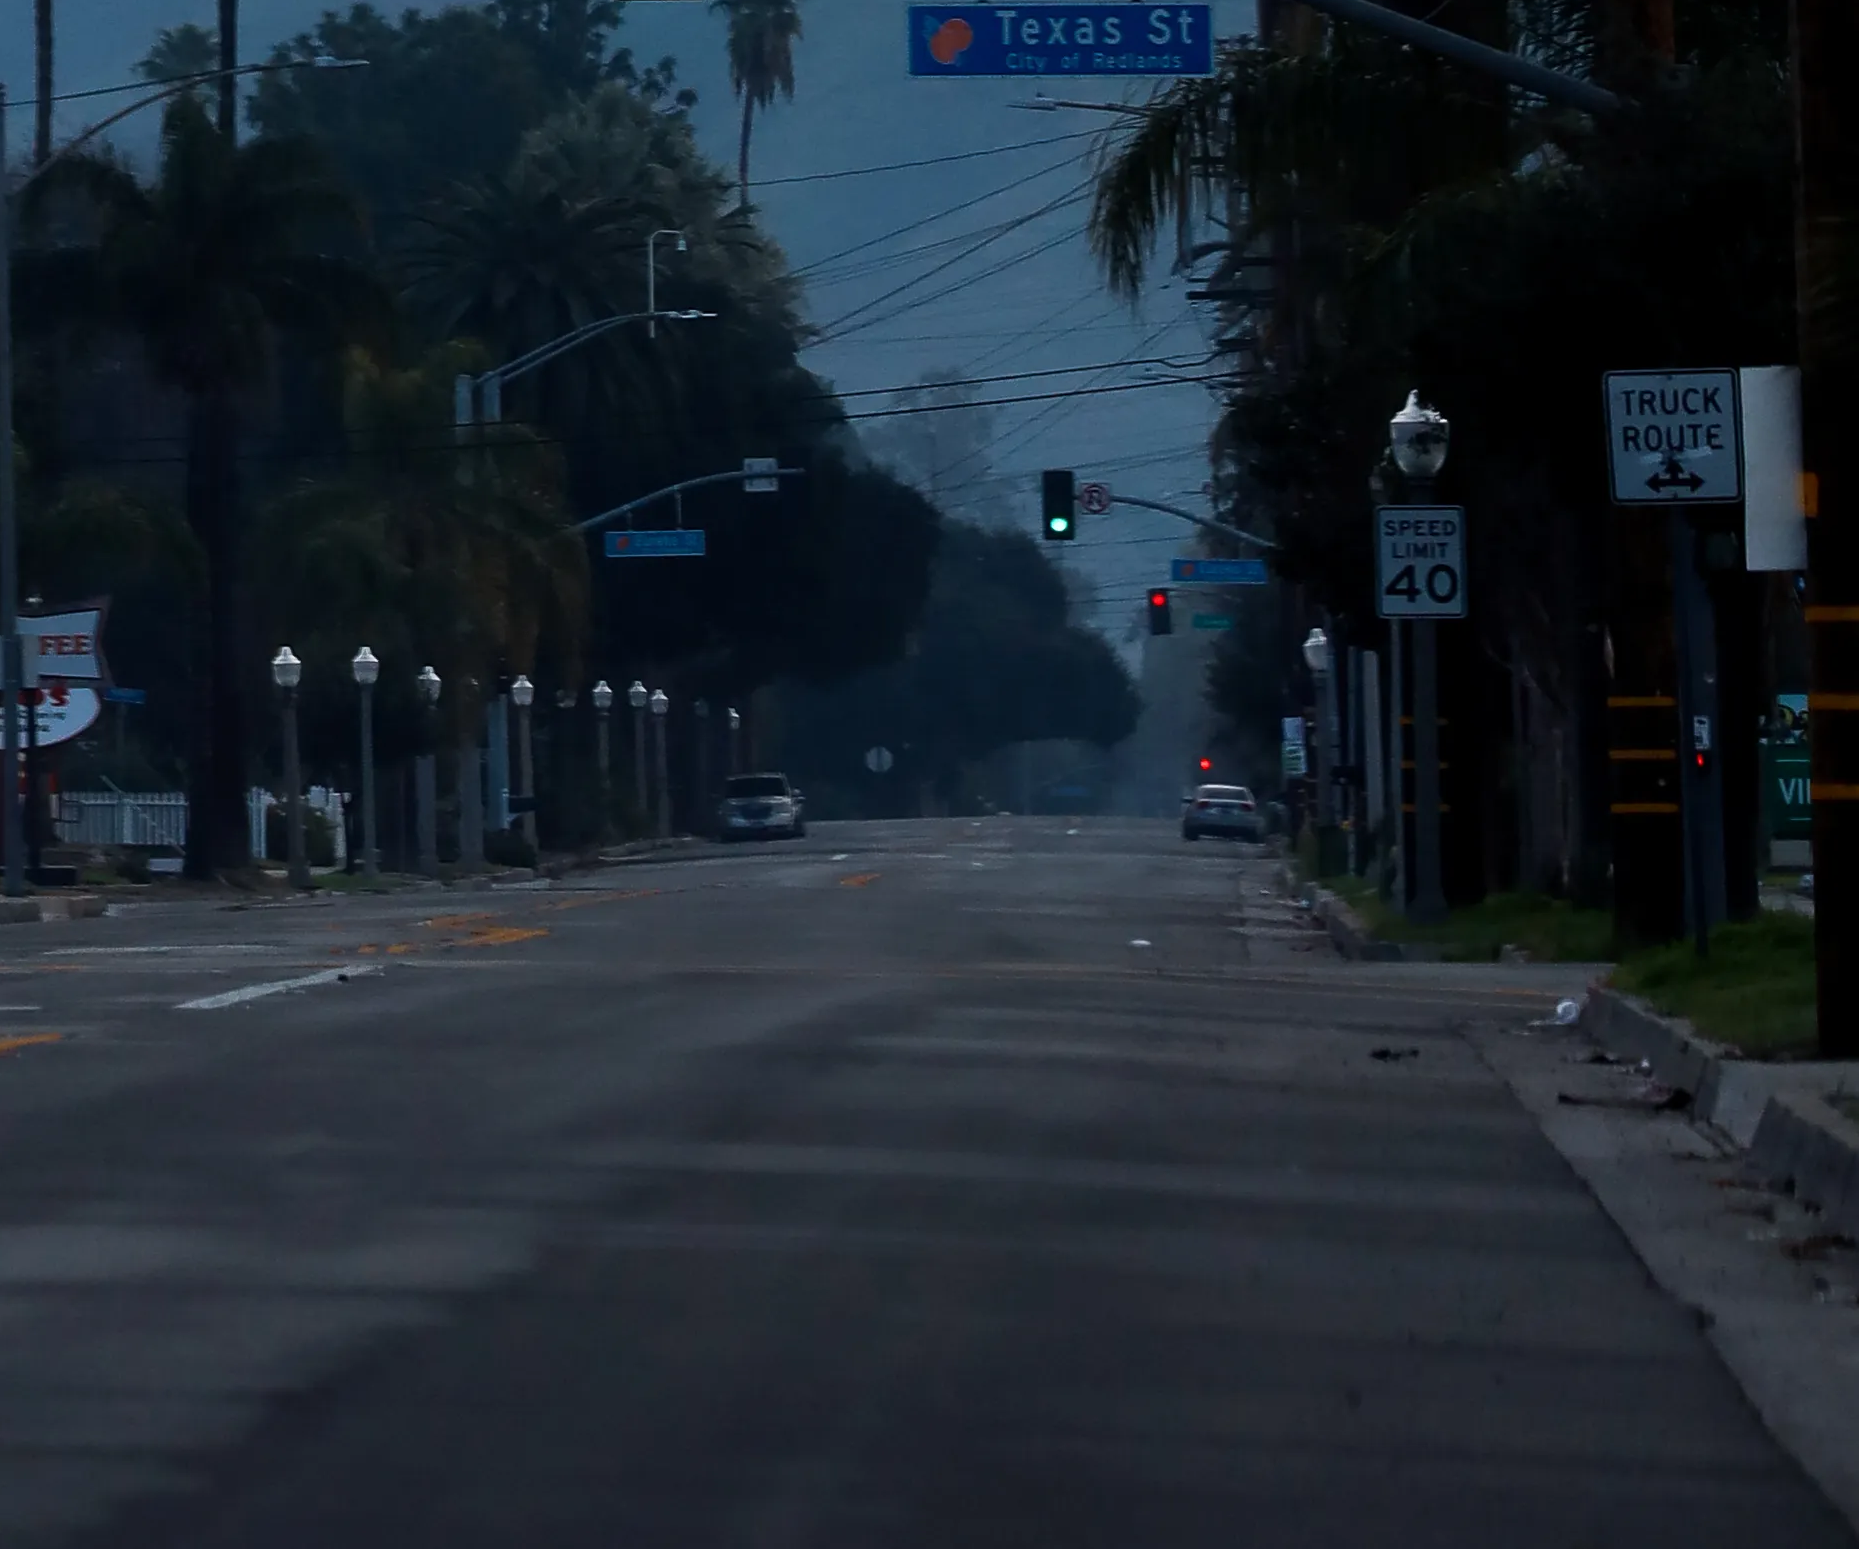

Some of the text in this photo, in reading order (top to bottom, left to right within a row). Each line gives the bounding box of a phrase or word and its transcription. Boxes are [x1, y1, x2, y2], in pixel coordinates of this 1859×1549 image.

[995, 8, 1195, 46] Texas St
[1005, 52, 1183, 72] City of Redlands
[1621, 387, 1722, 416] TRUCK
[1622, 423, 1725, 453] ROUTE
[1384, 519, 1457, 536] SPEED
[1392, 542, 1448, 558] LIMIT
[1385, 563, 1458, 604] 40
[38, 634, 91, 655] FEE
